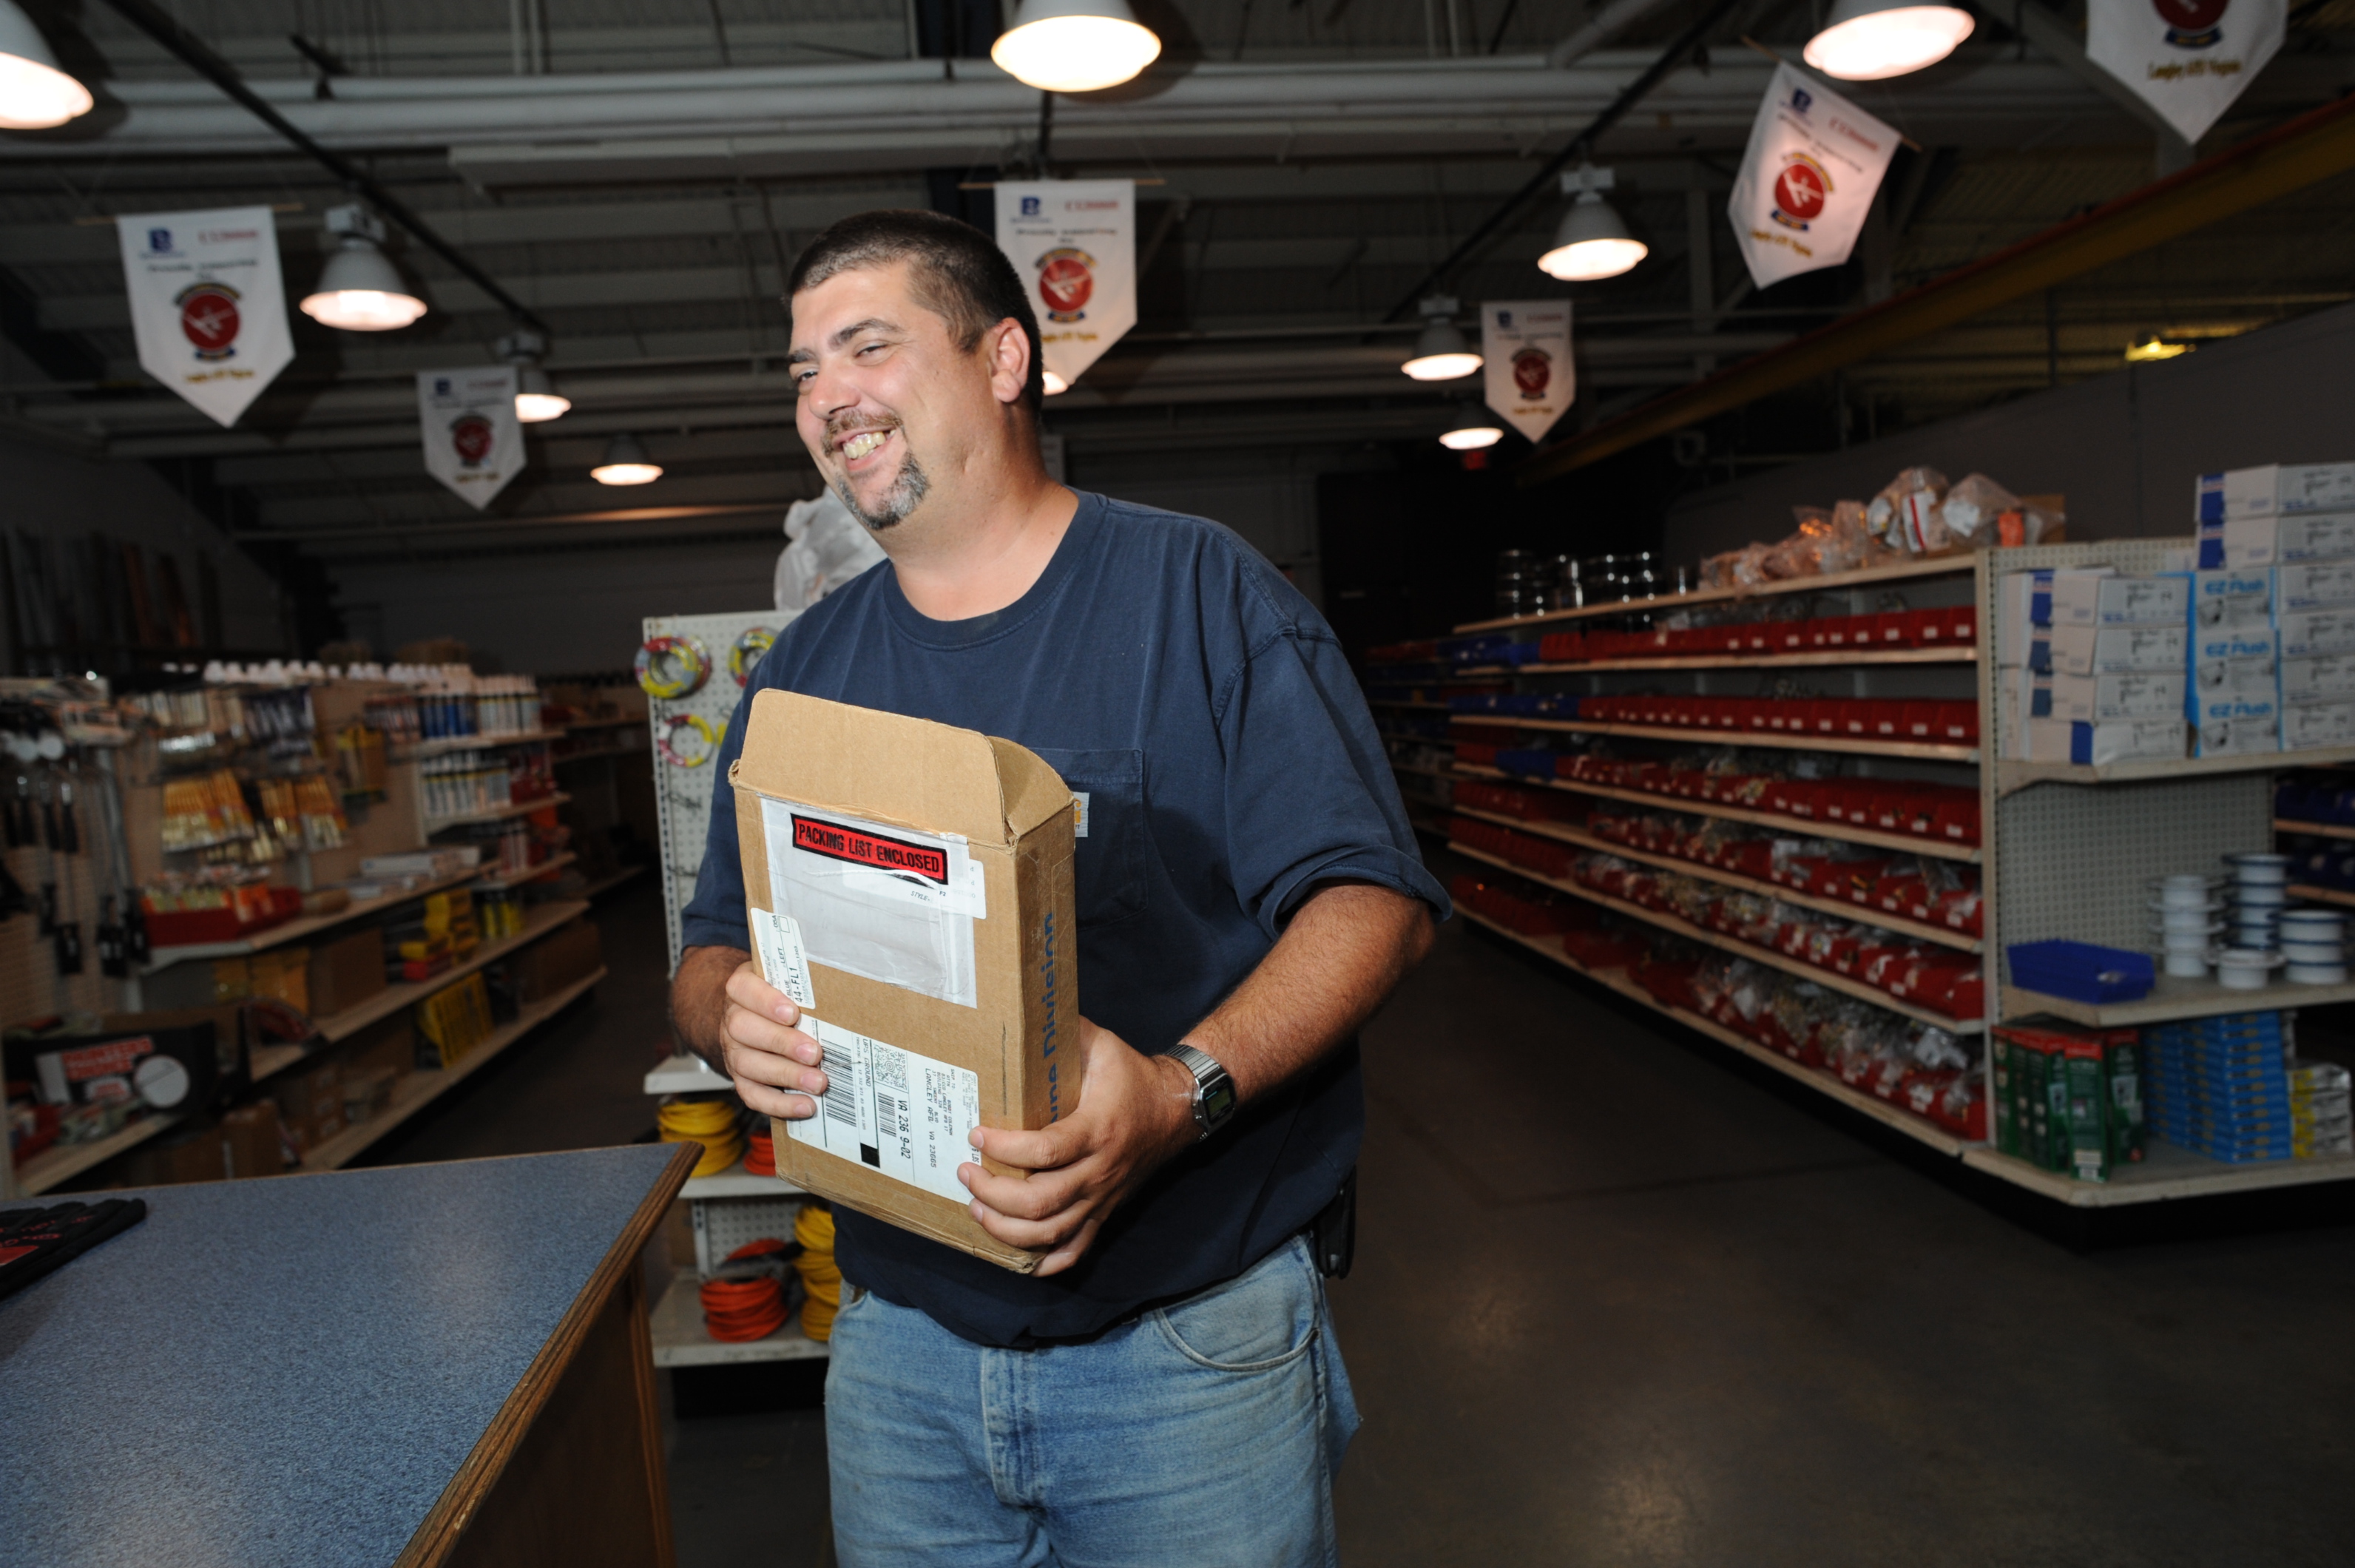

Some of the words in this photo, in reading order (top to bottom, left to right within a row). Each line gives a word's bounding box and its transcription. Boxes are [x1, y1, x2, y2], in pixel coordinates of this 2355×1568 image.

[799, 824, 844, 851] PACKING
[849, 838, 872, 857] LIST
[876, 845, 939, 872] ENCLOSED
[788, 967, 803, 1002] 44-FL1
[897, 1100, 908, 1111] VA
[899, 1115, 910, 1132] 236
[929, 1131, 935, 1140] VA
[899, 1136, 911, 1159] 9-02
